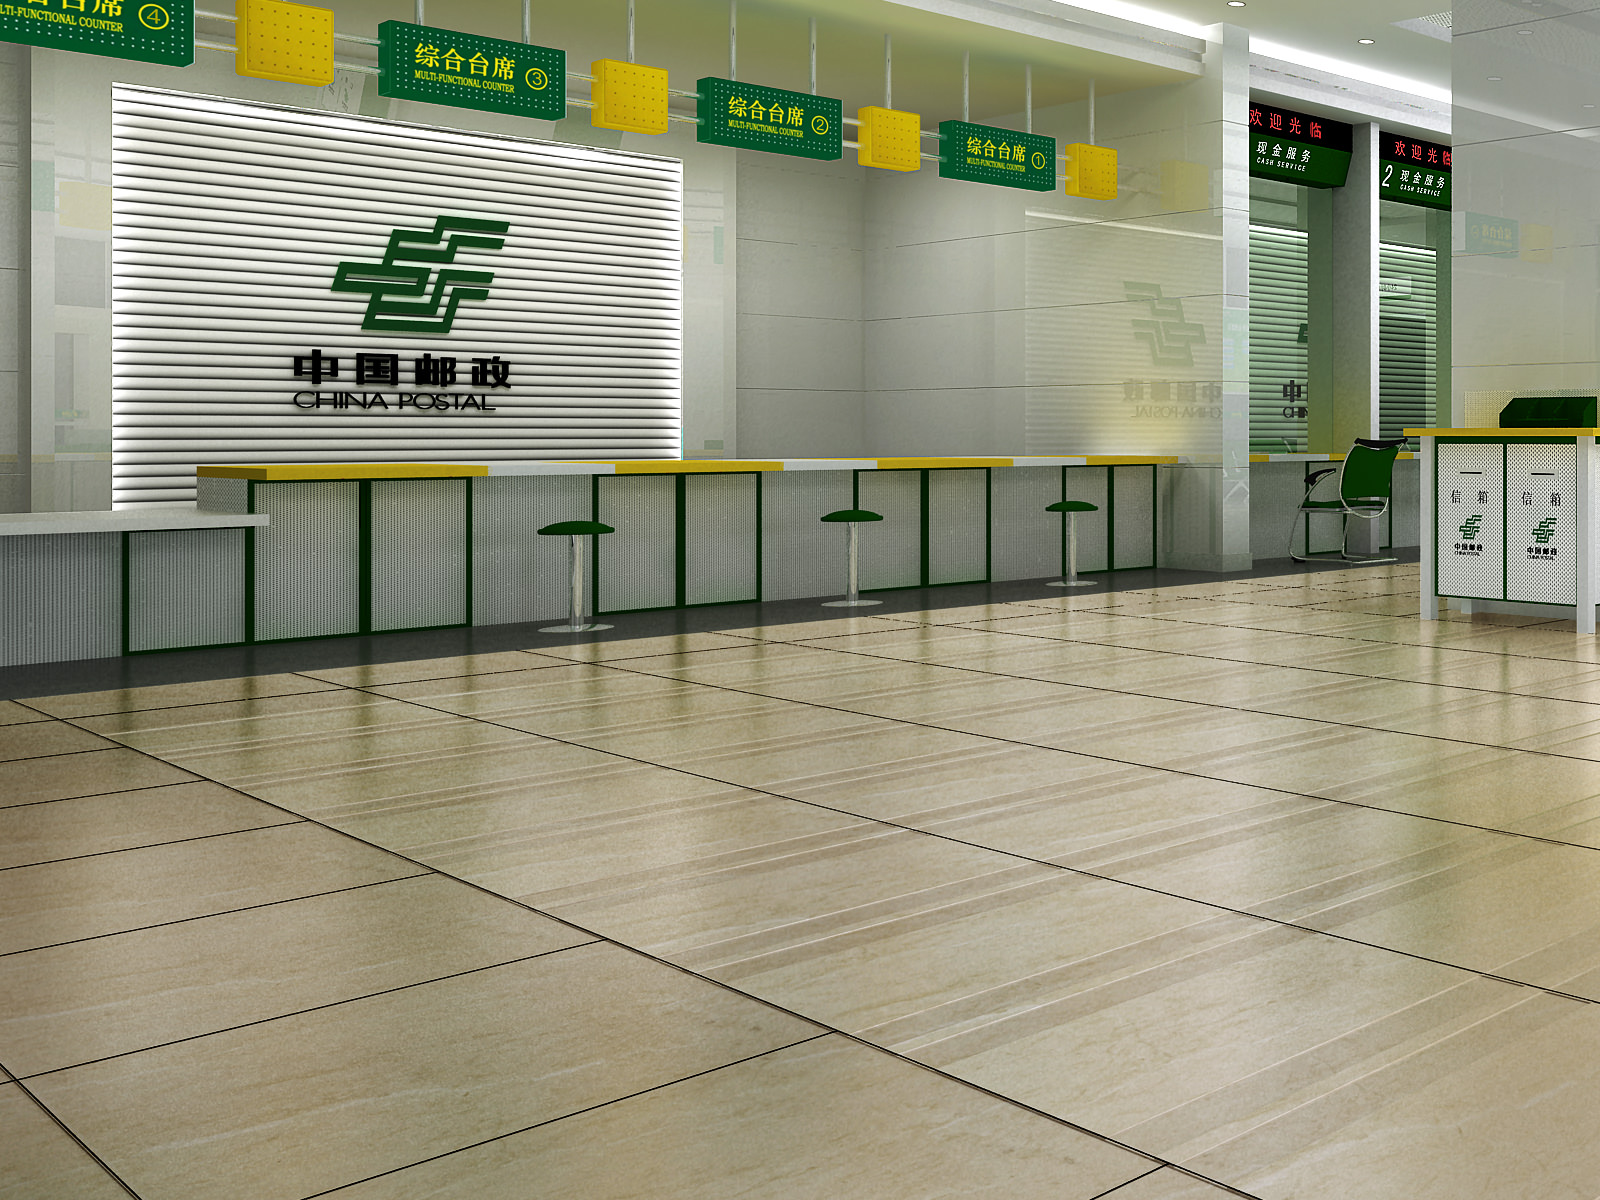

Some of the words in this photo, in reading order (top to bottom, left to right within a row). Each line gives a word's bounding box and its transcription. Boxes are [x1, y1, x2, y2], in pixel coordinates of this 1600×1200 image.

[79, 16, 124, 33] COUNTER
[414, 42, 516, 81] 综合台席
[414, 69, 481, 88] MULTI-FUNCTIONAL
[482, 80, 515, 94] COUNTER
[728, 95, 804, 127] 综合台席
[728, 119, 778, 135] MULTI-FUNCTIONAL
[779, 127, 804, 138] COUNTER
[1250, 109, 1322, 139] 欢迎光临
[966, 136, 1026, 163] 综合台席
[1256, 141, 1312, 163] 现金服务
[1256, 157, 1274, 167] CASH
[1277, 160, 1307, 172] SERVICE
[1381, 164, 1394, 188] 2
[1399, 169, 1445, 189] 现金服务
[293, 349, 512, 389] 中国邮政
[293, 391, 389, 410] CHINA
[398, 392, 497, 411] POSTAL
